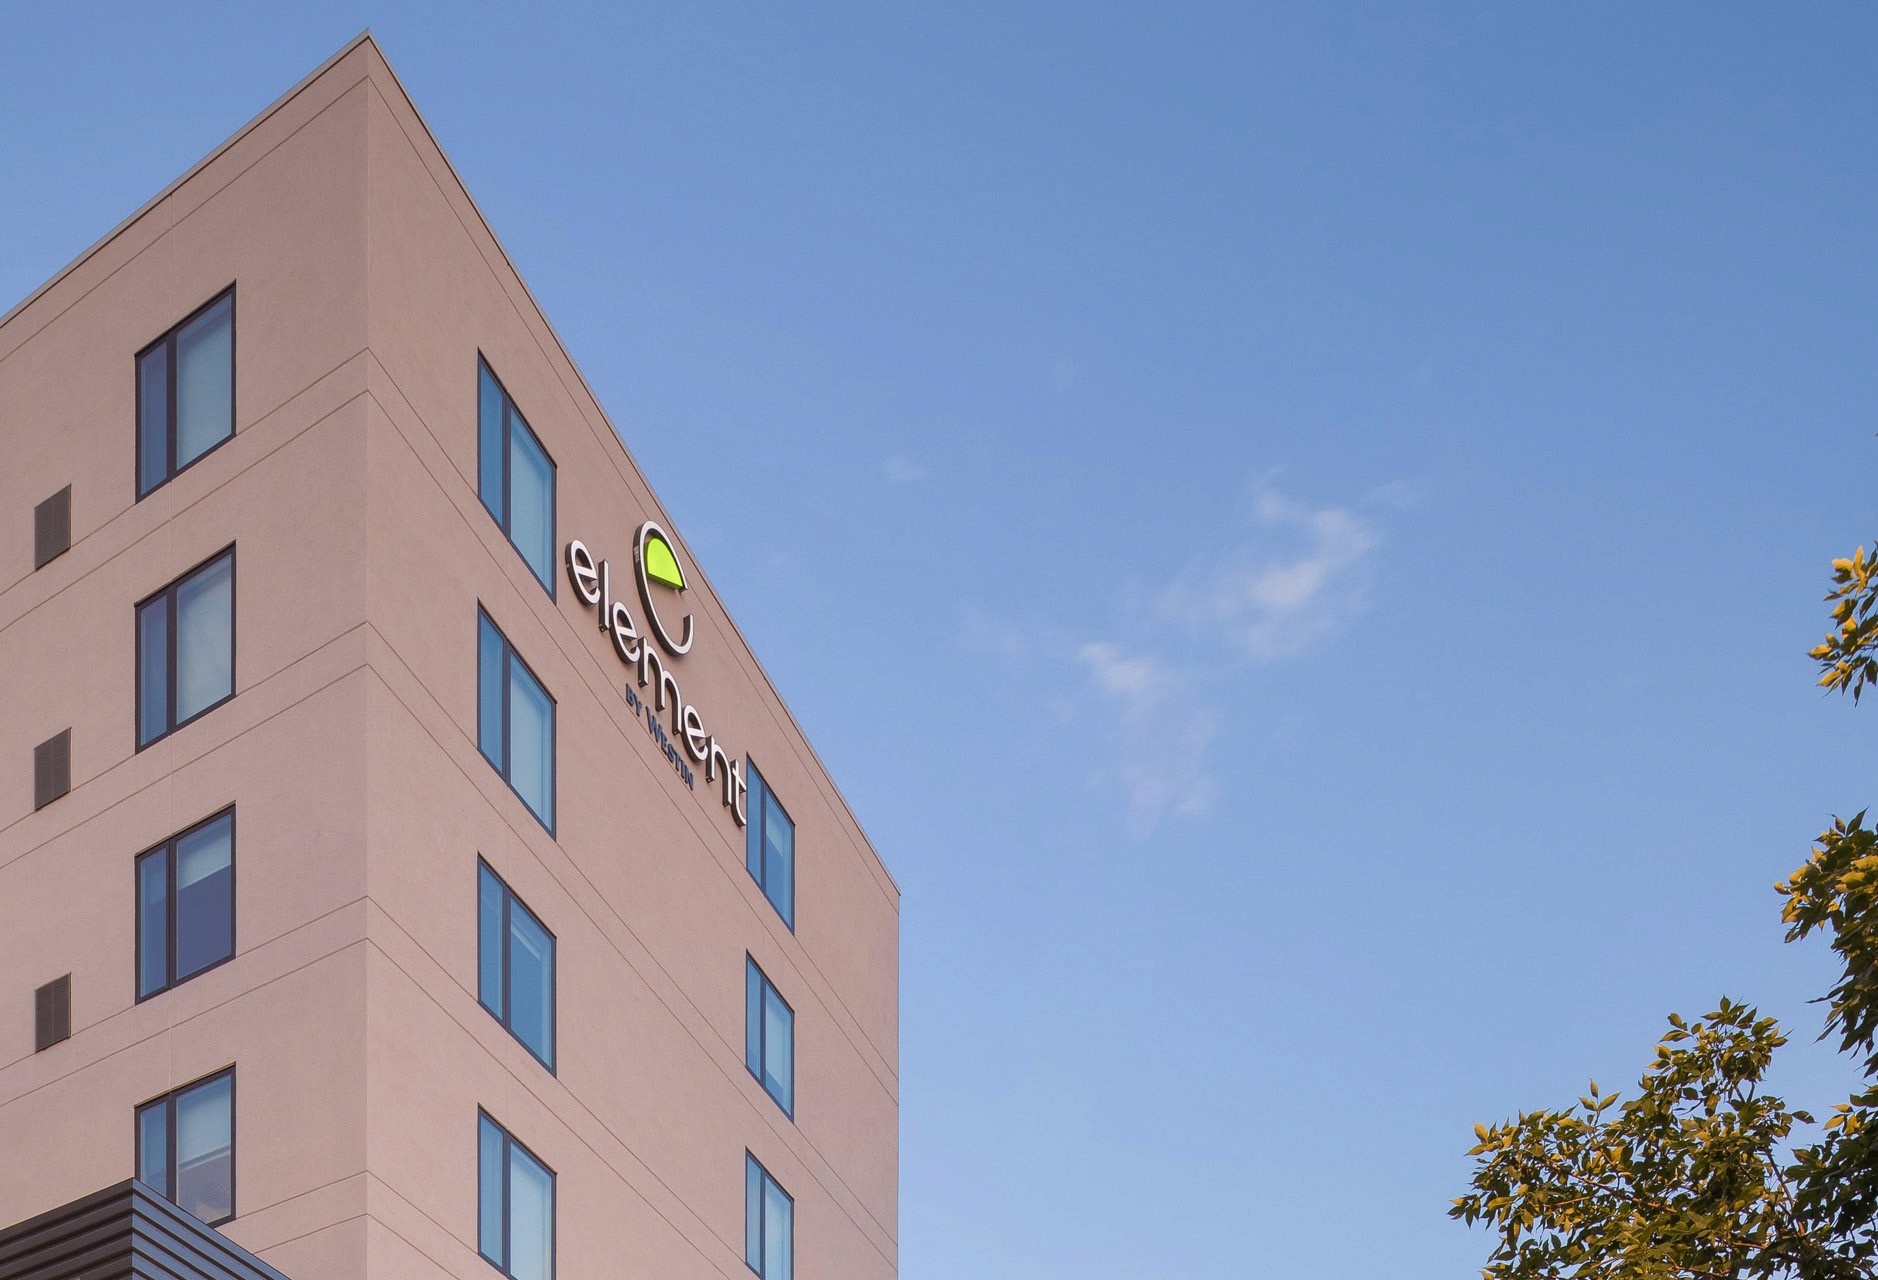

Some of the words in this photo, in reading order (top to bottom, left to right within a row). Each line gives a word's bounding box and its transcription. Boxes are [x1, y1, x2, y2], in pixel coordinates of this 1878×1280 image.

[565, 540, 746, 828] element
[625, 682, 643, 718] BY
[645, 706, 695, 792] WESTIN
